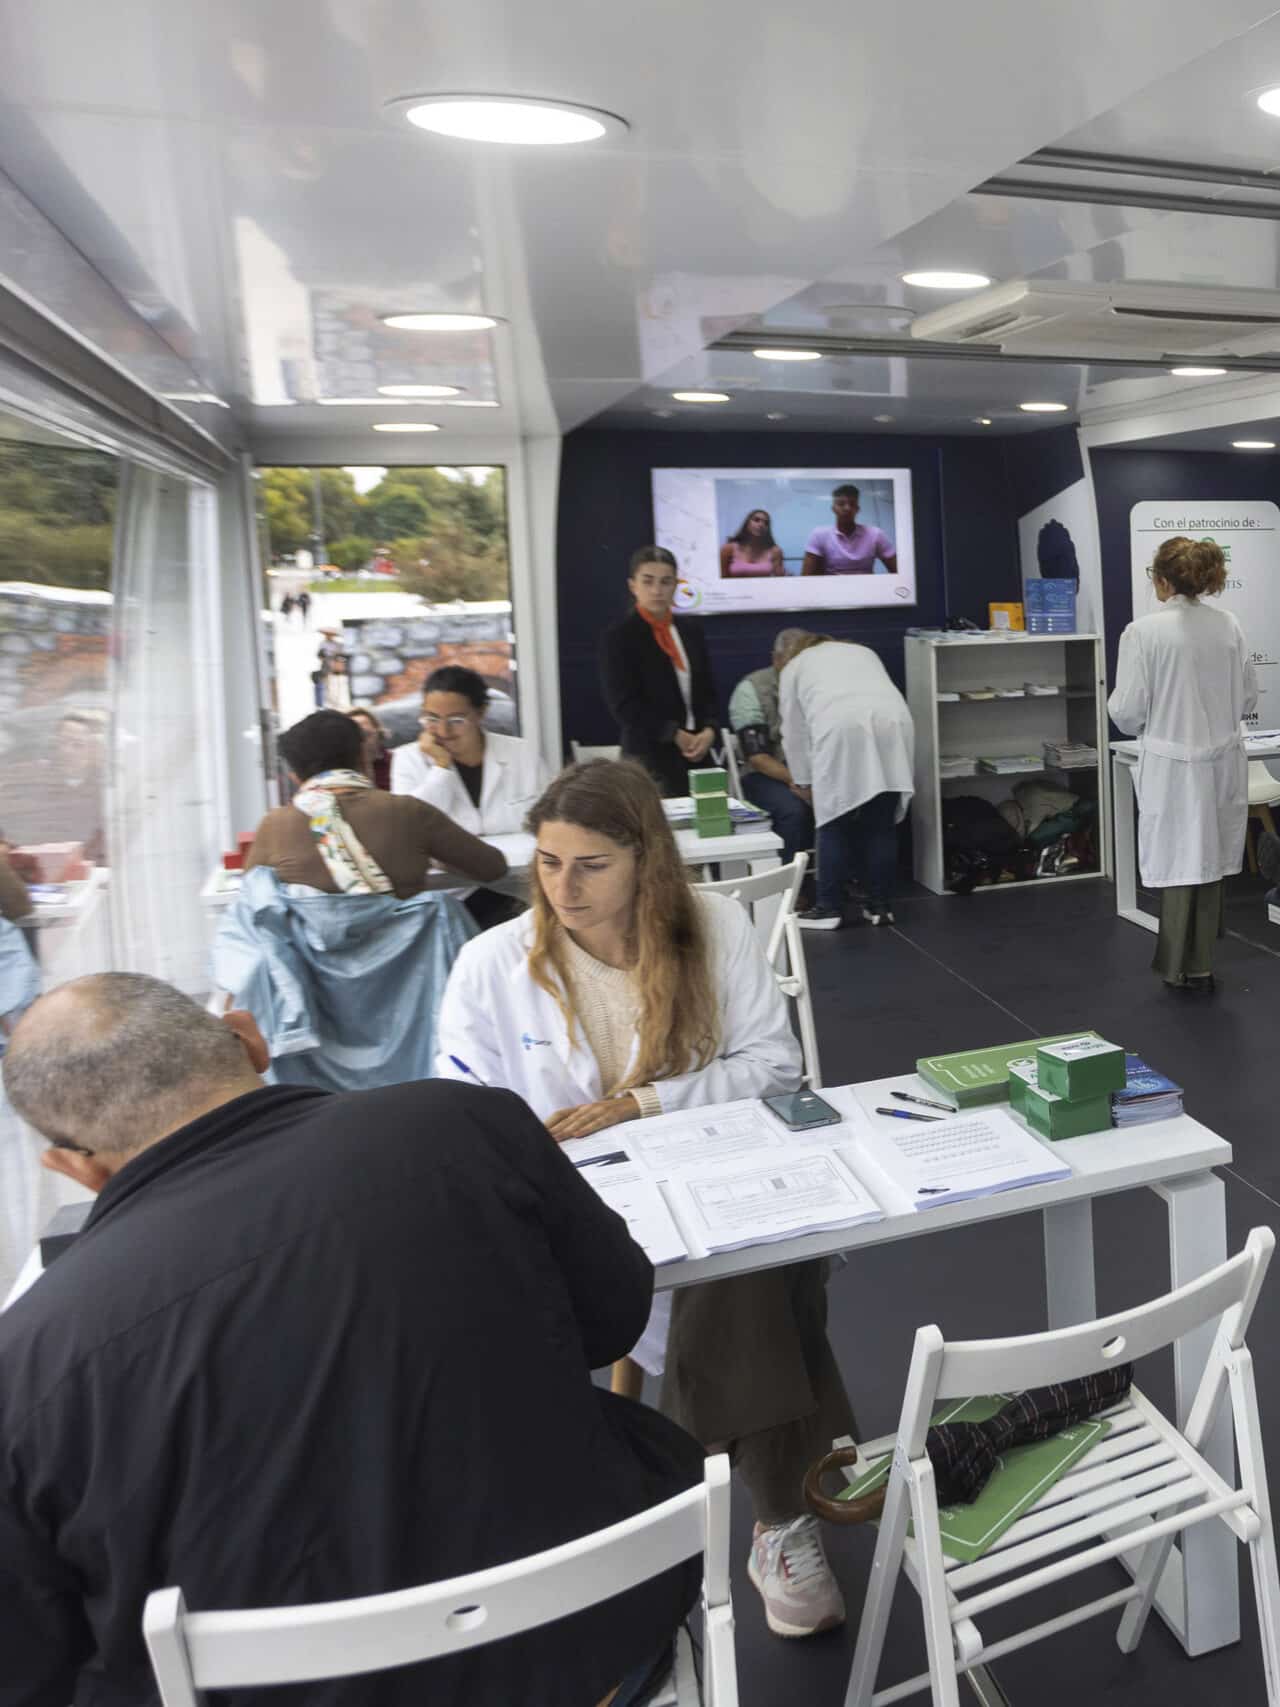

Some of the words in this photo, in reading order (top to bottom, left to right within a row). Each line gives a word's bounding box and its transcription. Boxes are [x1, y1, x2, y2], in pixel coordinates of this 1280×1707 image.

[1153, 518, 1175, 528] Con
[1177, 517, 1186, 528] el
[1189, 517, 1240, 530] patrocinio
